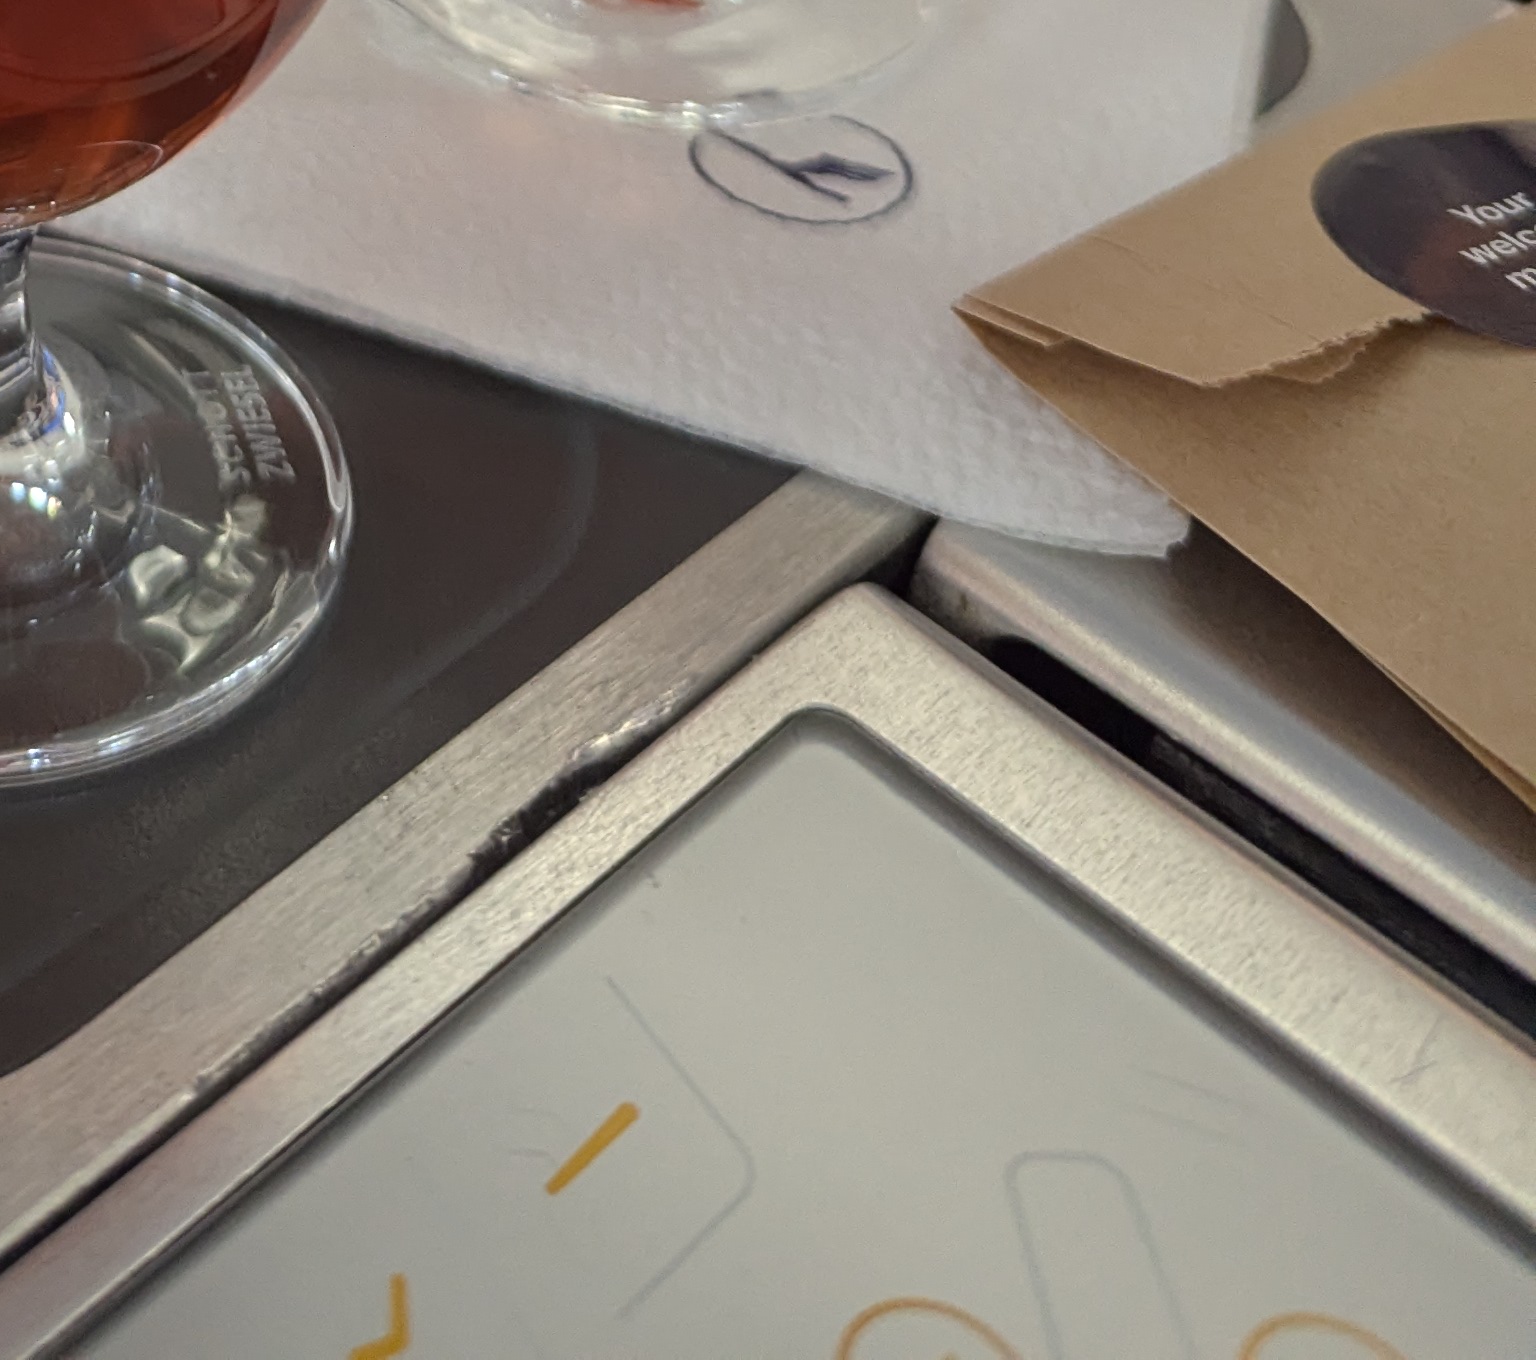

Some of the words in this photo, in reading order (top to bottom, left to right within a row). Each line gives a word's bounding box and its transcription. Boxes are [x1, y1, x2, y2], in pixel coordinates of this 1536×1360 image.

[1446, 191, 1535, 226] Your
[1457, 224, 1536, 266] welc
[220, 364, 296, 483] ZWIESEL
